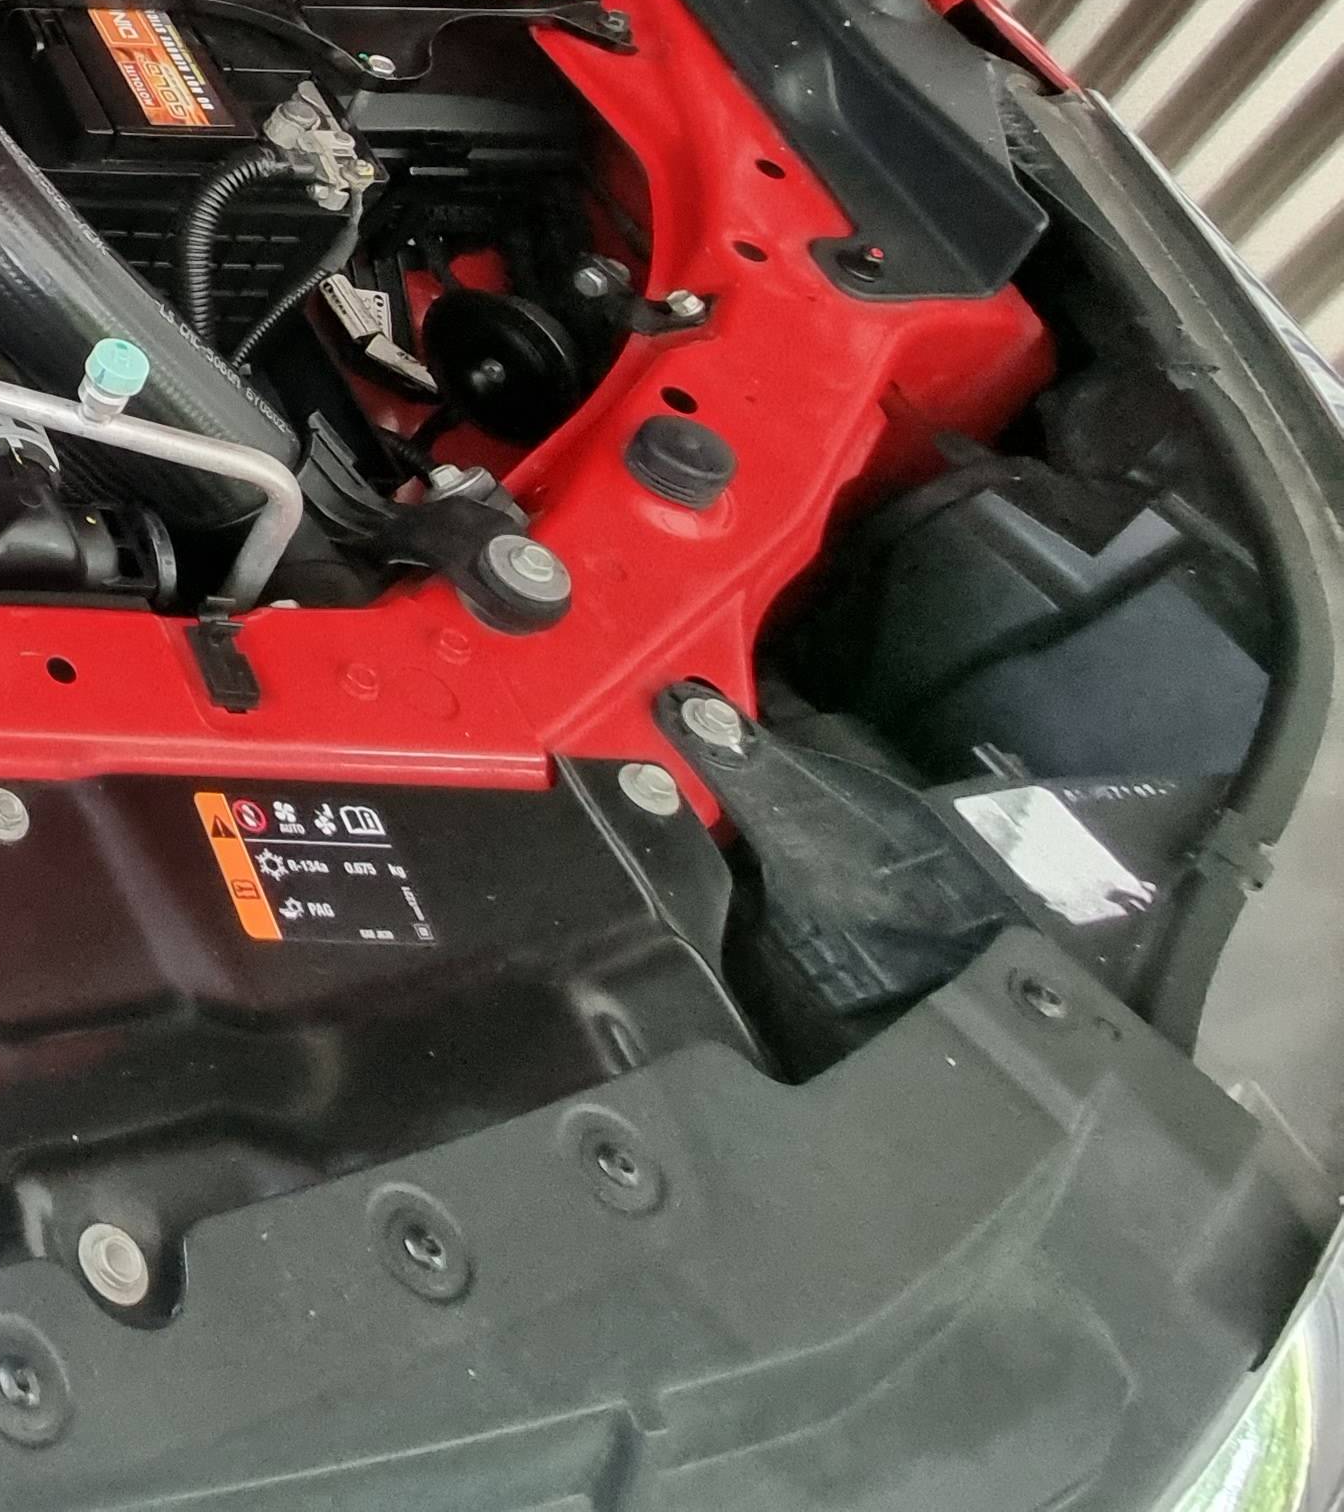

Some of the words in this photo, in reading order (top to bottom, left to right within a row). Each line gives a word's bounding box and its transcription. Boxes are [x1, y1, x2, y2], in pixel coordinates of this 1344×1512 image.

[123, 62, 155, 108] MOTOLITE
[144, 61, 188, 119] GOLD
[183, 75, 205, 94] NOT
[197, 96, 215, 111] DO
[279, 823, 306, 835] AUTO
[286, 859, 330, 874] R-134a
[387, 863, 408, 879] kg
[307, 902, 336, 918] PAG
